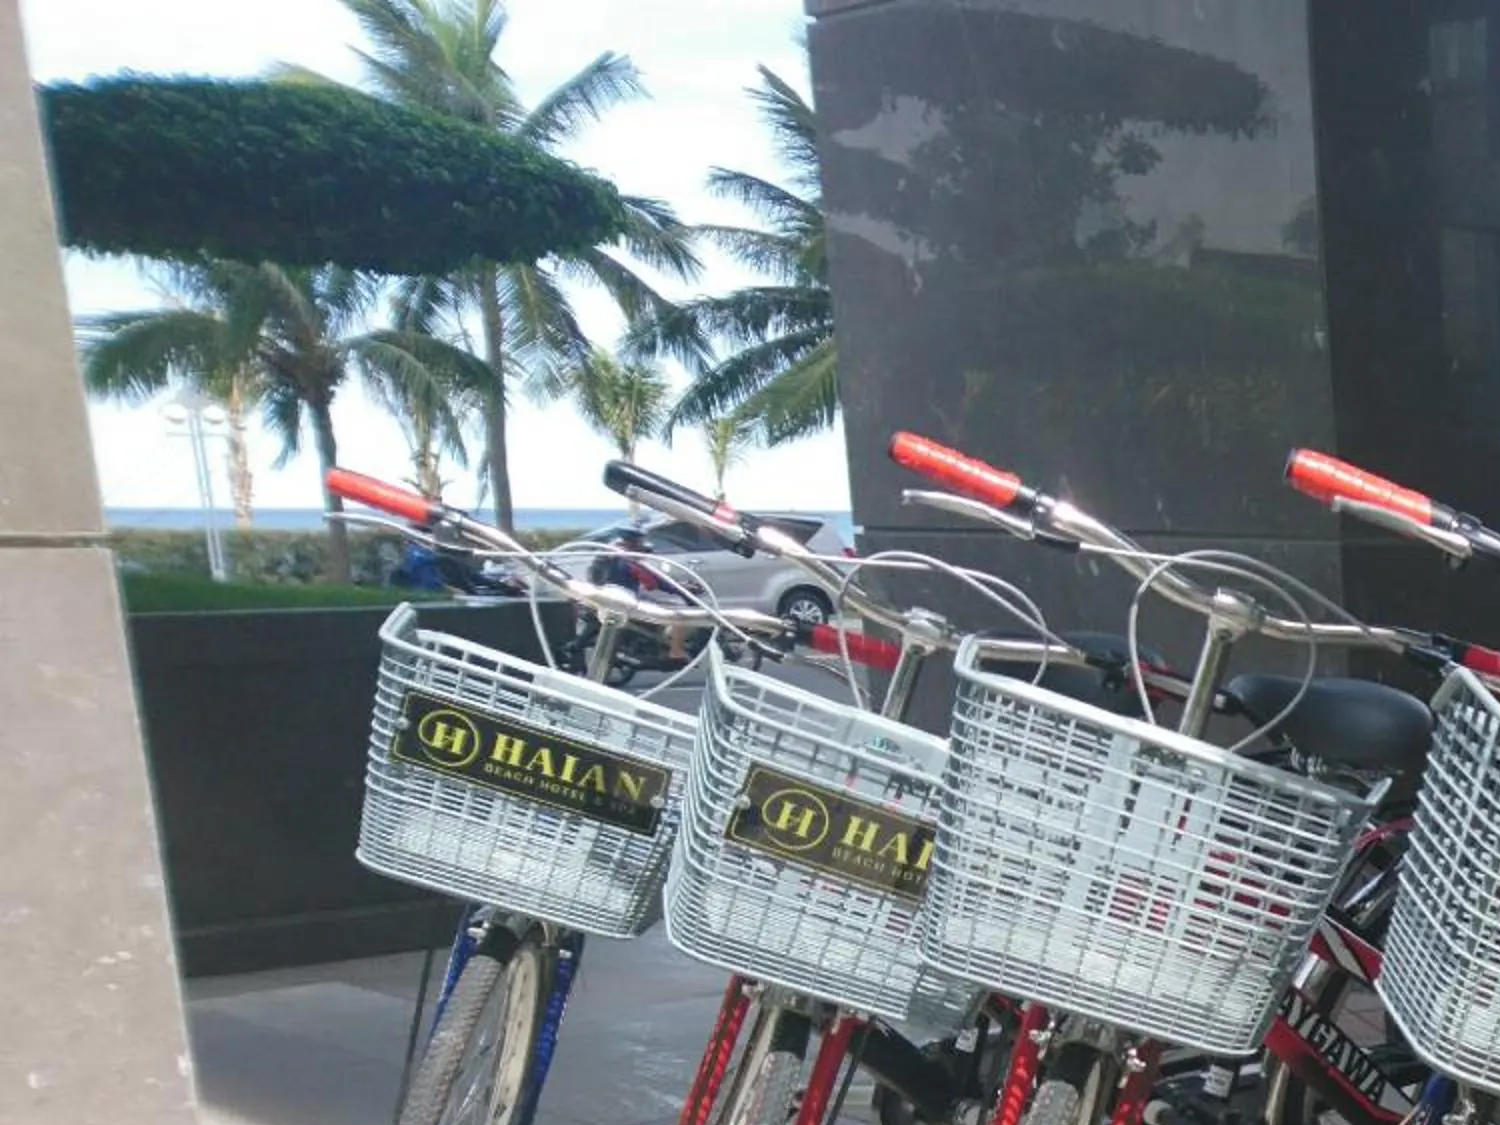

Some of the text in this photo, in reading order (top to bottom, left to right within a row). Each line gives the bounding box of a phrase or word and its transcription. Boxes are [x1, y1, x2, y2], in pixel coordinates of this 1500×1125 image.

[431, 721, 468, 755] H
[484, 762, 534, 786] BEACH
[540, 779, 585, 802] HOTEL
[490, 732, 648, 801] HAIAN
[776, 801, 817, 838] H
[831, 846, 886, 874] BEACH
